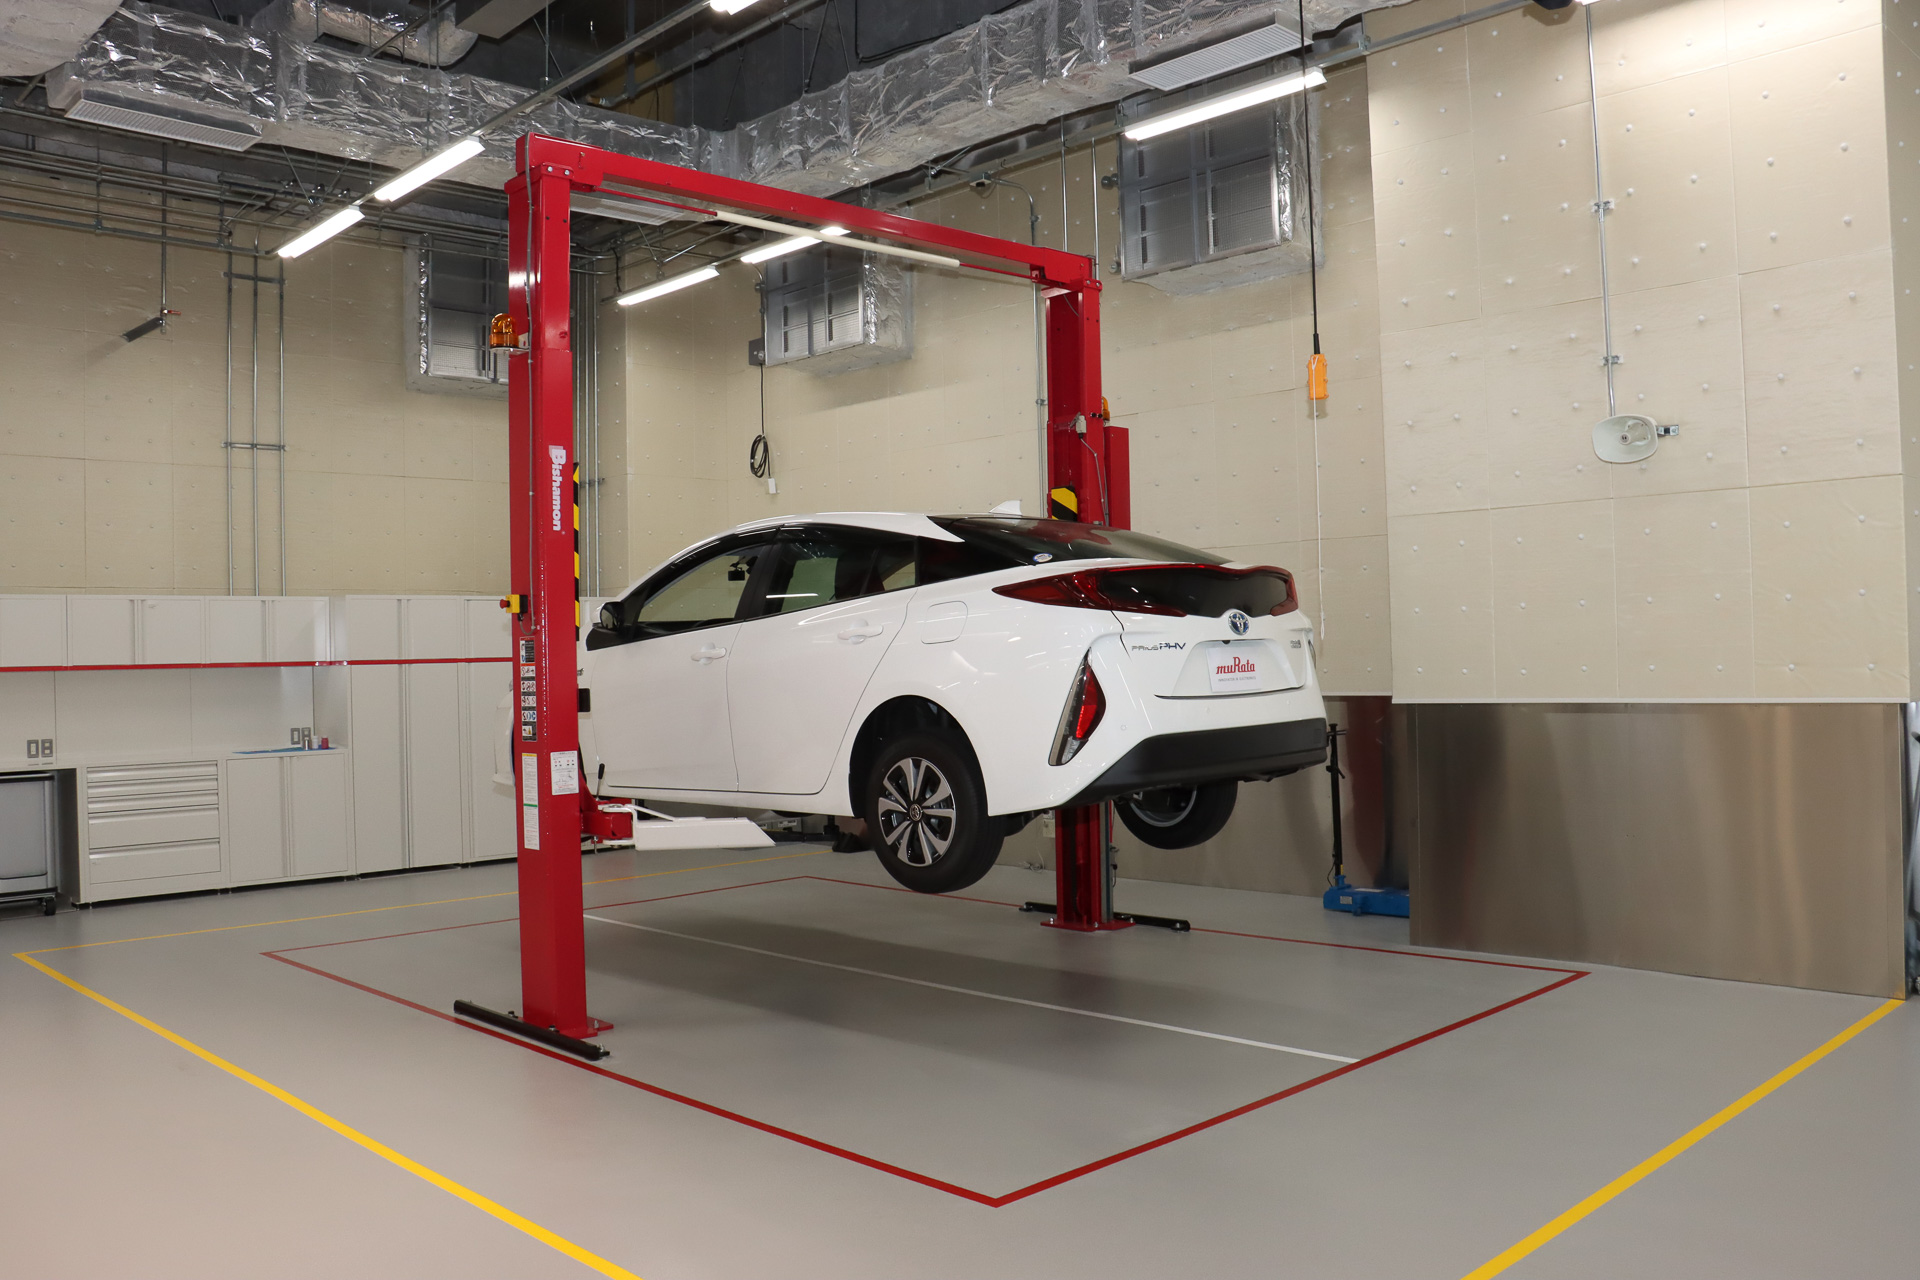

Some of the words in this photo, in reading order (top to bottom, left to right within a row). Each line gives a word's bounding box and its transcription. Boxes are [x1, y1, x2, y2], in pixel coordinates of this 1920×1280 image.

[549, 445, 567, 531] Bishamon
[1159, 642, 1187, 650] PHV
[1215, 656, 1256, 674] muRata
